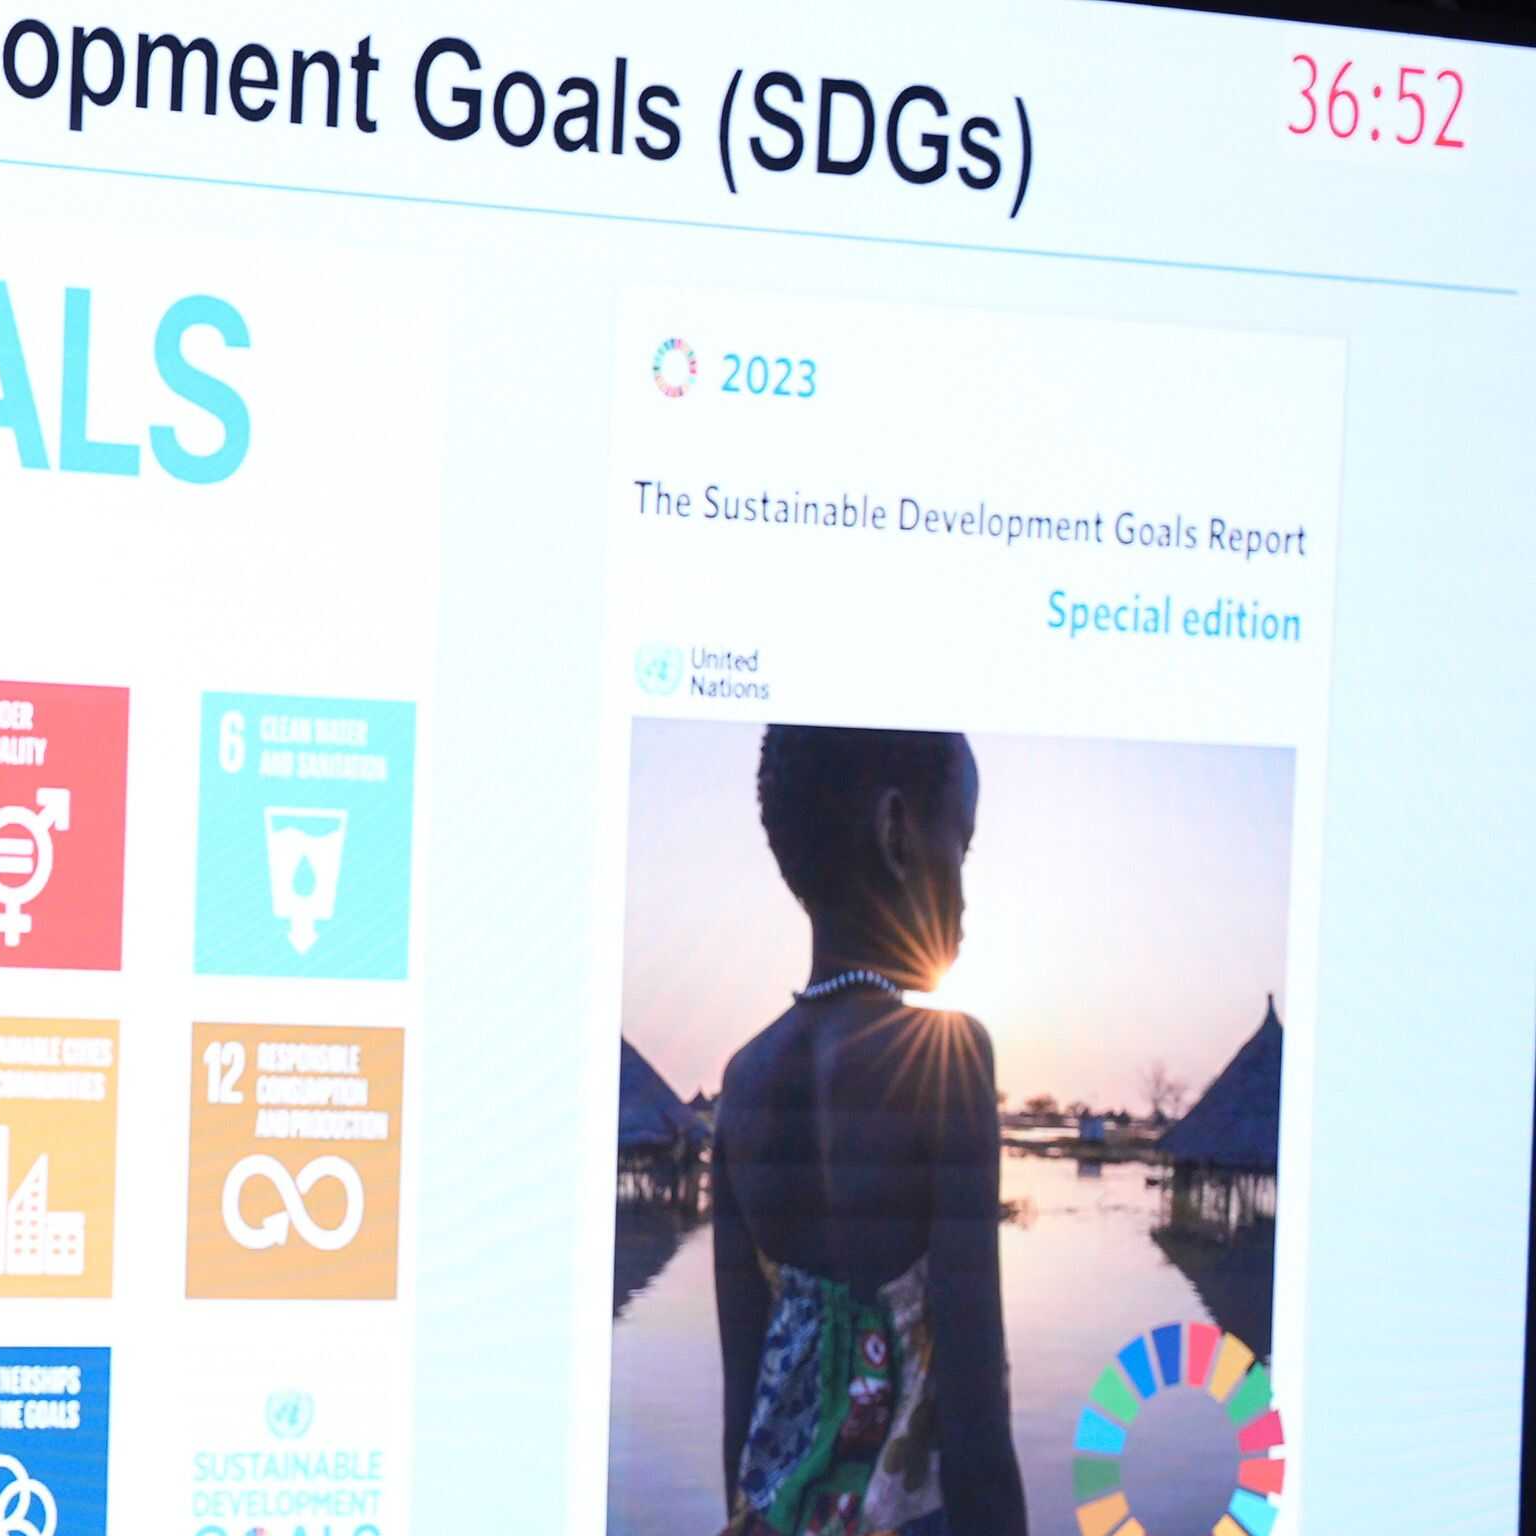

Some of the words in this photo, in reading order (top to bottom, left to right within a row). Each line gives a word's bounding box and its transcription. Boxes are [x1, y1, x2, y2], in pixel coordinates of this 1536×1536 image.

[1288, 54, 1464, 148] 36:52
[415, 37, 680, 161] Goals
[719, 69, 1032, 218] (SDGs)
[721, 353, 816, 398] 2023
[634, 480, 691, 517] The
[704, 485, 886, 529] Sustainable
[899, 498, 1103, 546] Development
[1115, 512, 1197, 548] Goals
[1209, 518, 1306, 560] Report
[1048, 590, 1171, 638] Special
[1183, 598, 1301, 640] edition
[691, 647, 758, 672] United
[690, 675, 769, 700] Nations
[219, 709, 245, 774] 6
[203, 1040, 245, 1104] 12
[193, 1450, 384, 1482] SUSTAINABLE
[192, 1487, 383, 1519] DEVELOPMENT
